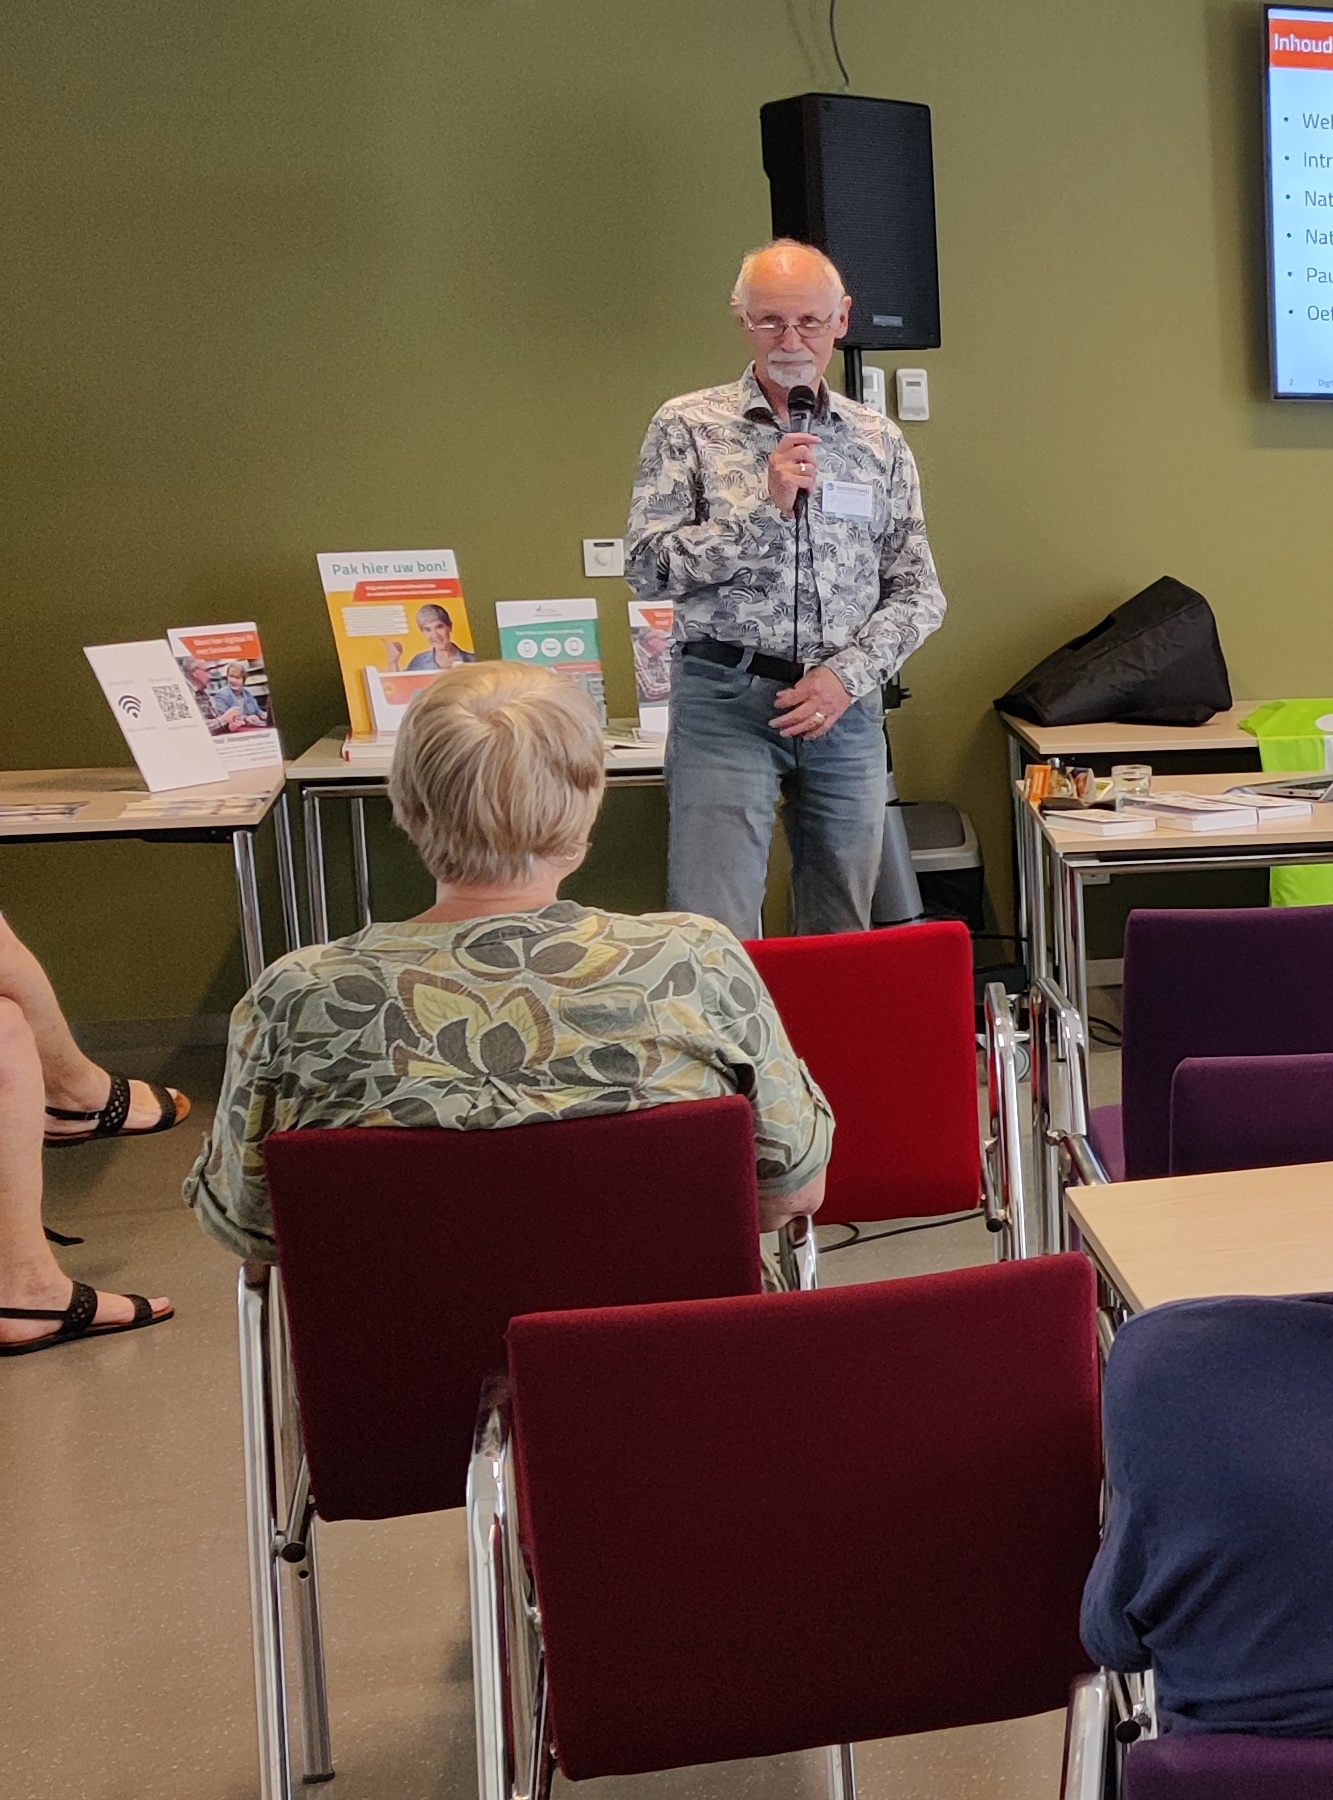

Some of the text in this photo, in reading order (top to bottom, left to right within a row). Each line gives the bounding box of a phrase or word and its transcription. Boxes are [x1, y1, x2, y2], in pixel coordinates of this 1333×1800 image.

[1273, 33, 1333, 54] Inhoud
[332, 560, 447, 576] Pak hier uw bon!
